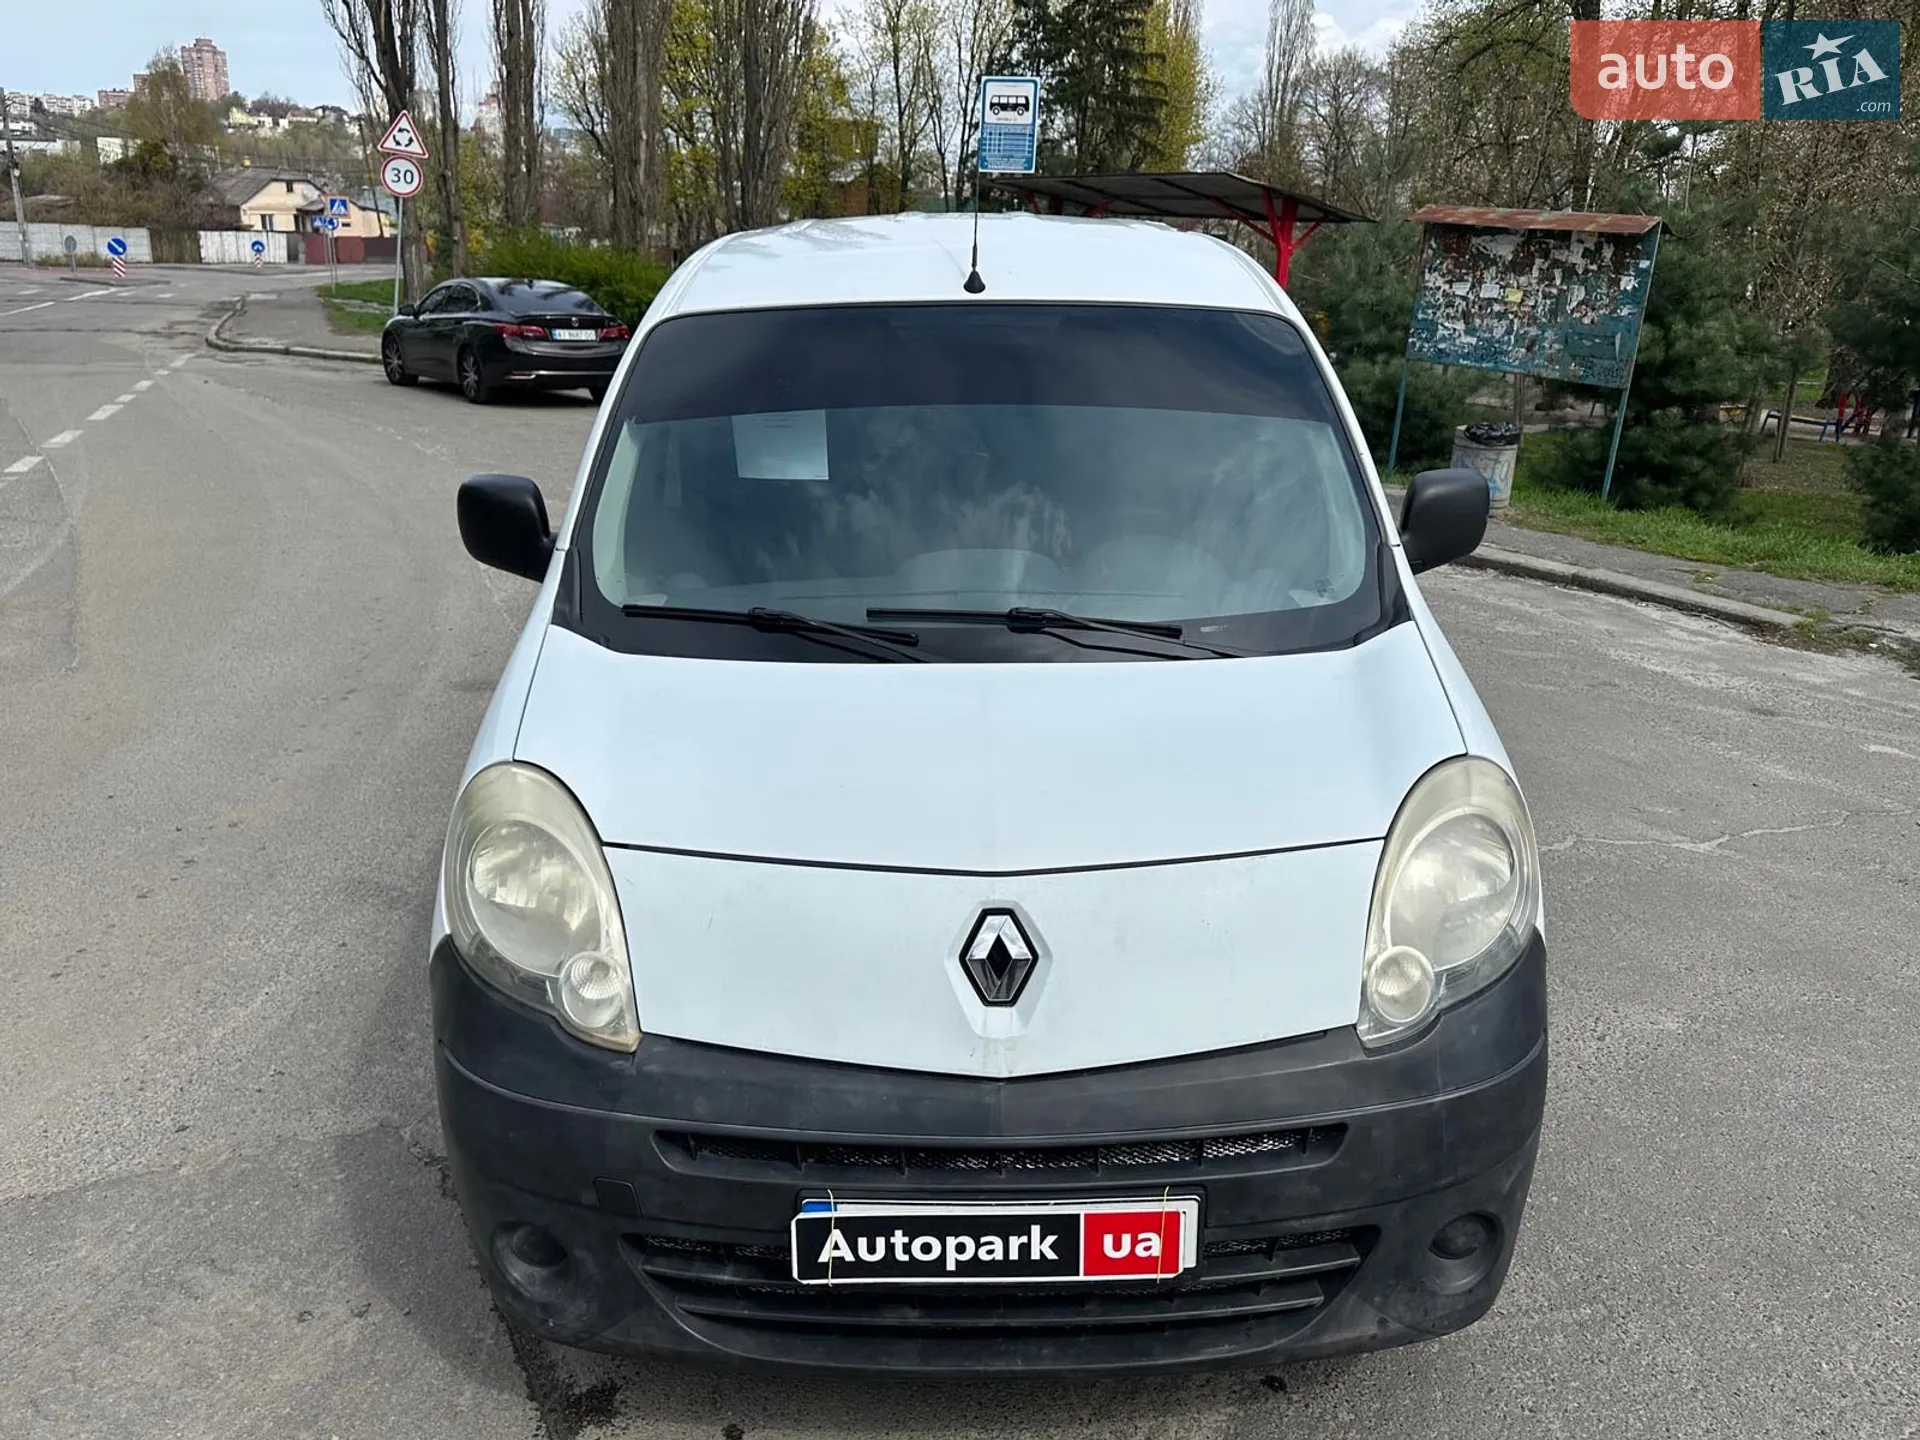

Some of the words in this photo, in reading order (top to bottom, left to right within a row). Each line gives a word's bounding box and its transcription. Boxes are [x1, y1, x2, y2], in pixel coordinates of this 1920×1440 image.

[391, 168, 414, 184] 30
[817, 1224, 1059, 1271] Autopark
[1102, 1232, 1161, 1258] ua
